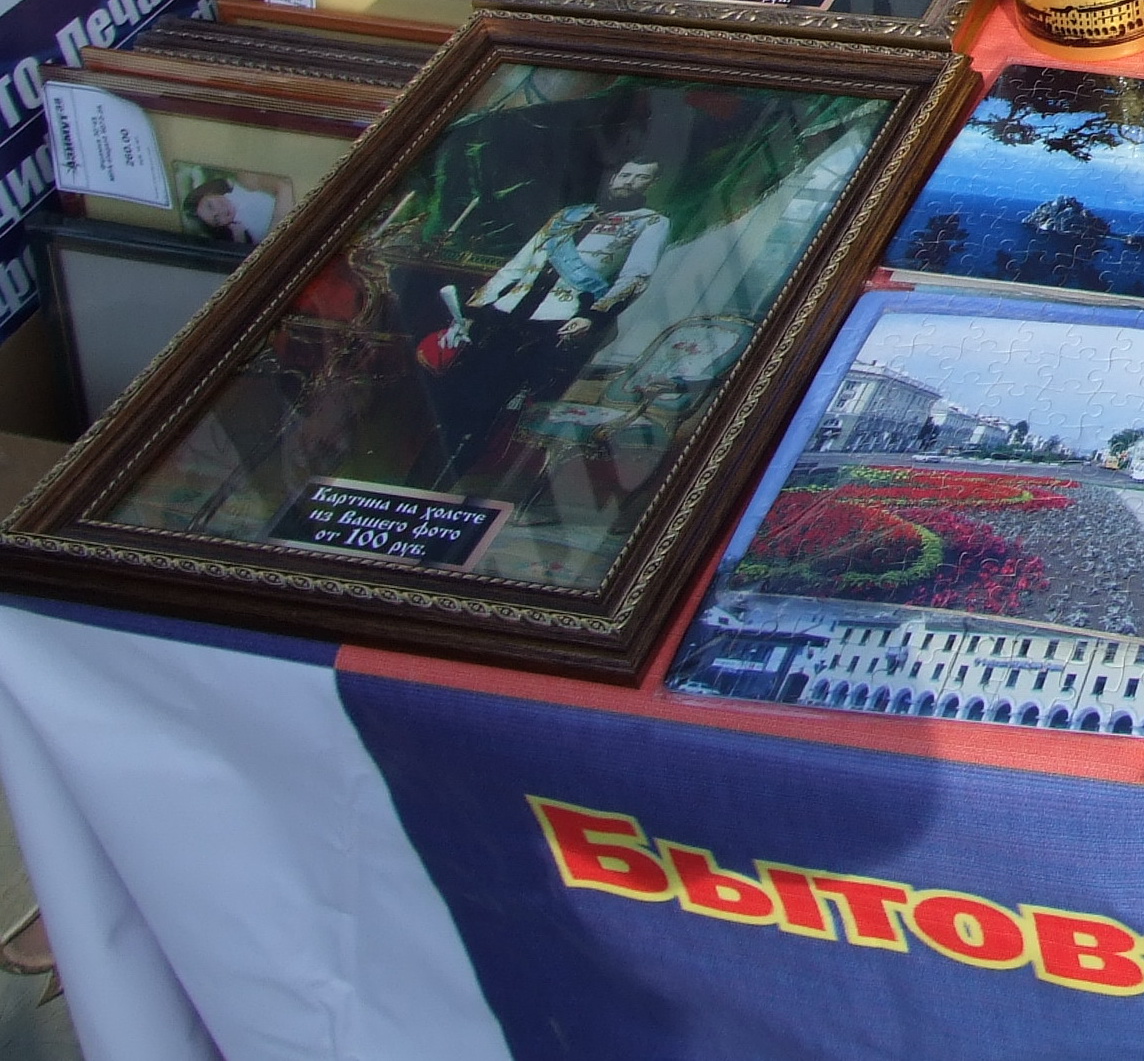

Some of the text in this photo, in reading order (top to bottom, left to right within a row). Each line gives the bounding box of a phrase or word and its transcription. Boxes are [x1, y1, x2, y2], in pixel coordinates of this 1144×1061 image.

[311, 487, 487, 525] Картина на холсте
[309, 509, 461, 541] из Вашего фото
[315, 528, 426, 557] от 100 руб.
